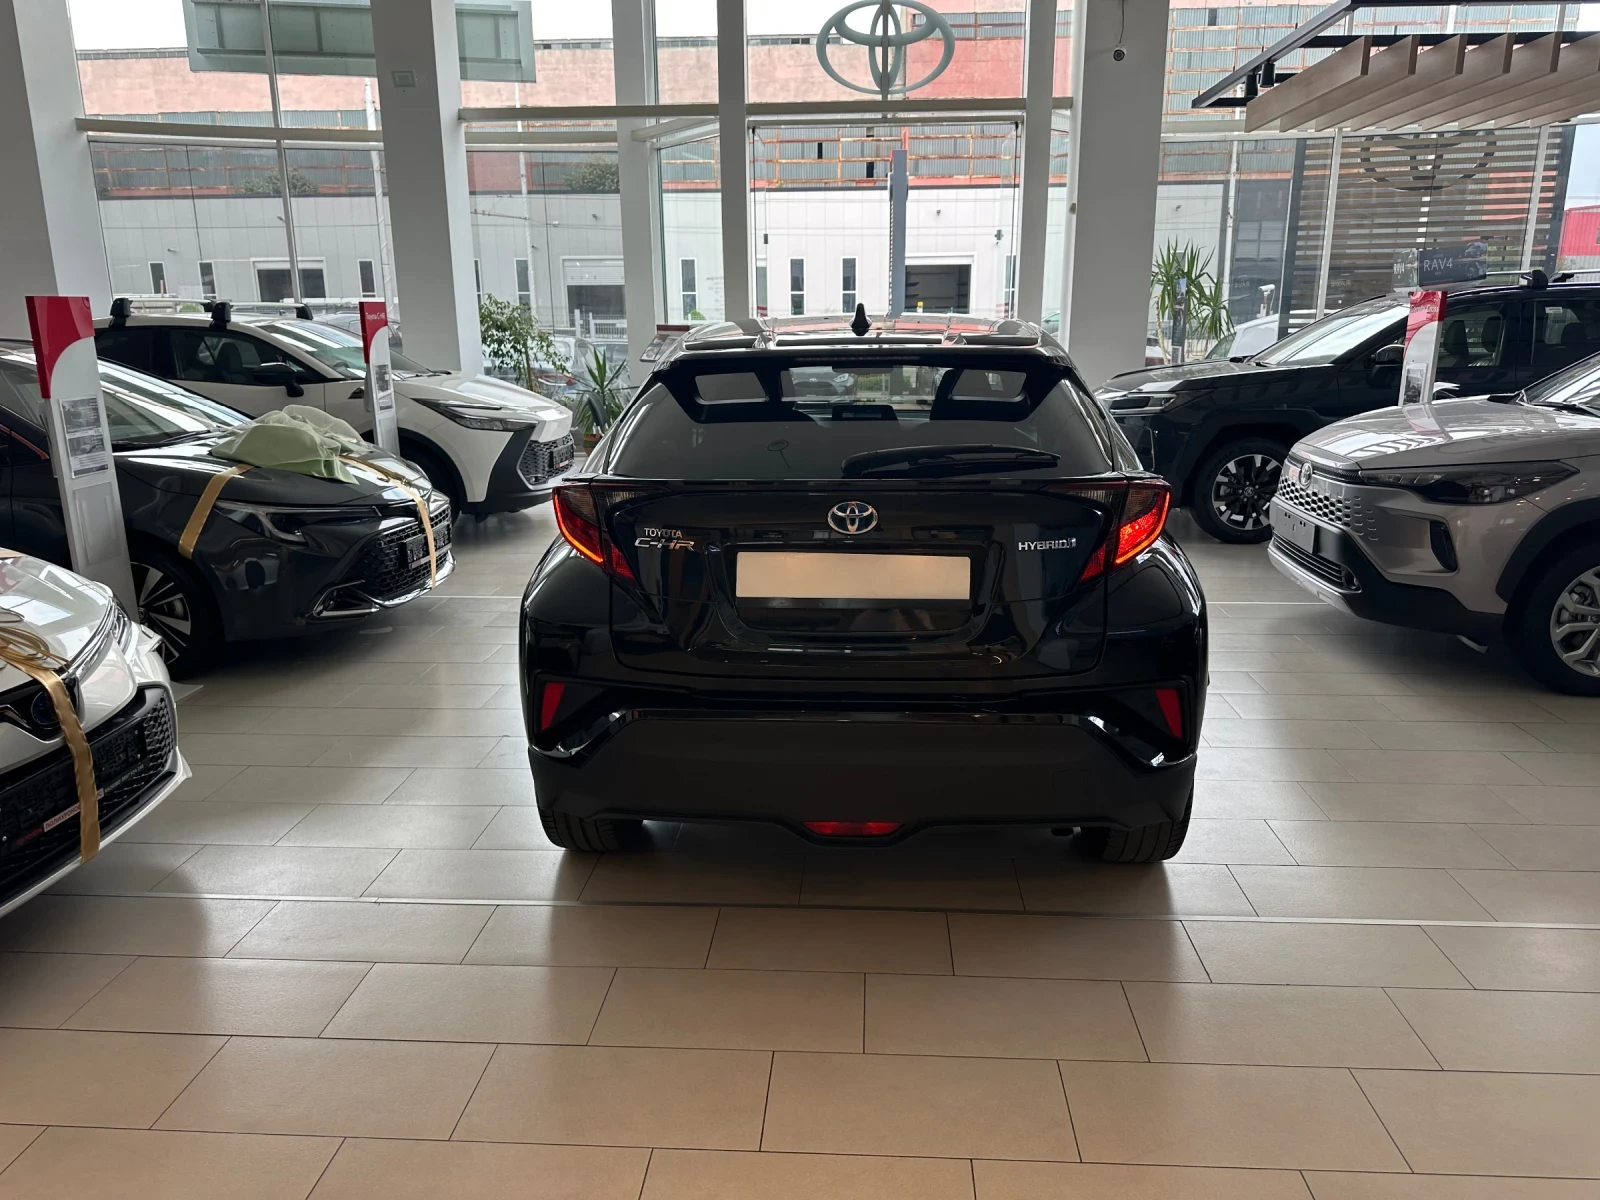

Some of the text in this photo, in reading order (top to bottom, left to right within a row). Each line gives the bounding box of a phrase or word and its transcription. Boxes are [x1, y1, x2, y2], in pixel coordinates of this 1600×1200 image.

[1423, 257, 1453, 272] RAV4
[365, 312, 377, 321] Toyota
[643, 527, 682, 538] TOYOTA
[634, 537, 695, 551] C-HR
[1018, 540, 1069, 550] HYBRID
